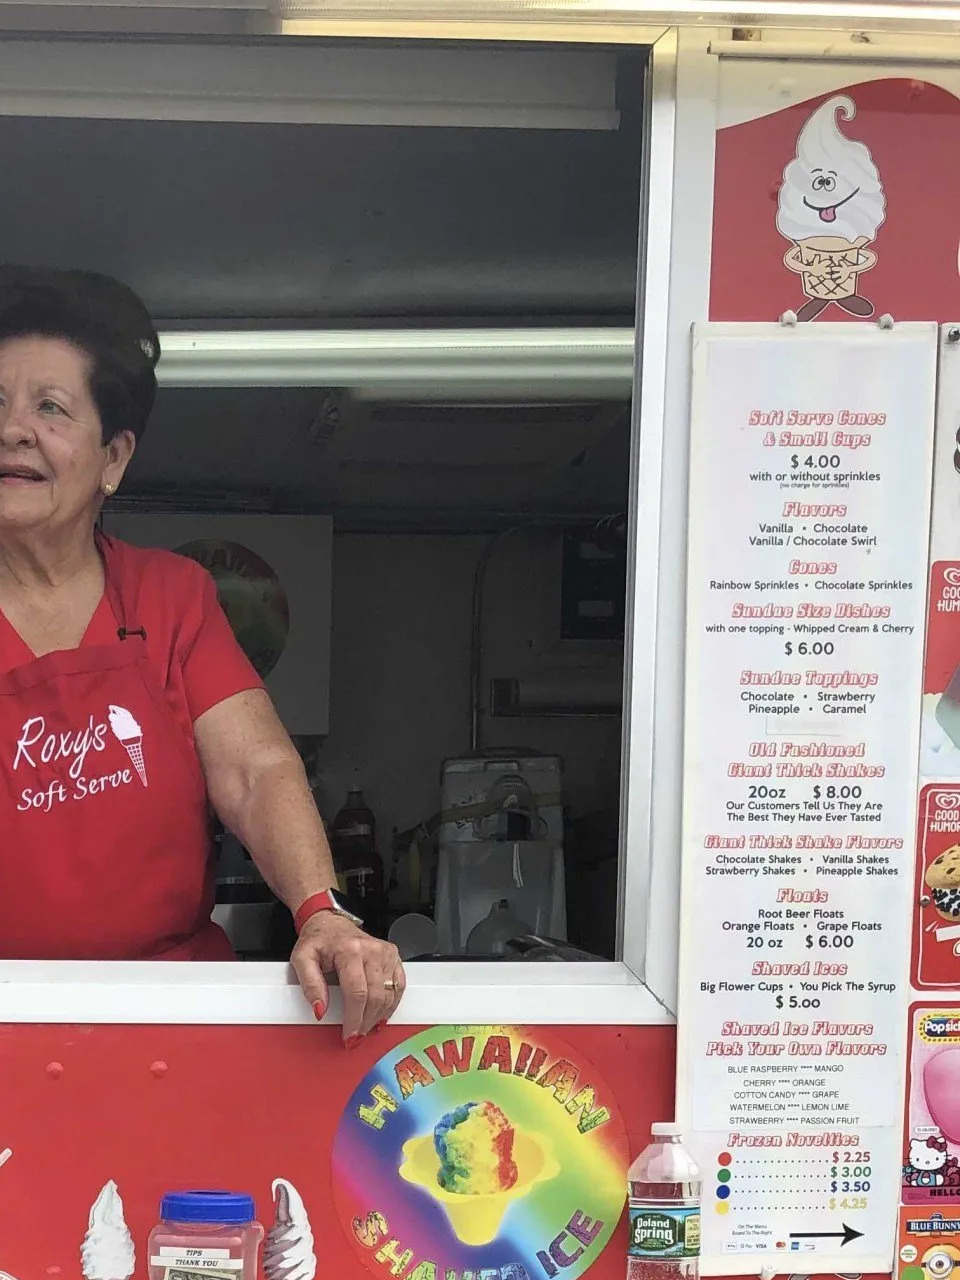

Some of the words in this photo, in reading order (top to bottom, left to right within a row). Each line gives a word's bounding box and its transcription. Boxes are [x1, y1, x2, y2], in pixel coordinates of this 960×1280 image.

[749, 410, 784, 426] Soft
[787, 410, 834, 426] Serve
[838, 410, 886, 426] Cones
[763, 432, 775, 446] &
[779, 432, 827, 446] Small
[832, 432, 871, 449] Cups
[750, 472, 771, 481] with
[790, 472, 830, 481] without
[833, 472, 881, 484] sprinkles
[783, 502, 847, 516] Flavors
[759, 523, 793, 533] Vanilla
[813, 523, 868, 533] Chocolate
[789, 560, 837, 574] Cones
[710, 581, 751, 589] Rainbow
[754, 581, 799, 591] Sprinkles
[814, 581, 866, 589] Chocolate
[869, 581, 913, 591] Sprinkles
[732, 604, 793, 618] Sundae
[797, 604, 831, 618] Size
[835, 604, 890, 618] Dishes
[740, 671, 801, 685] Sundae
[805, 671, 878, 688] Toppings
[740, 692, 794, 701] Chocolate
[817, 692, 875, 703] Strawberry
[749, 704, 800, 716] Pineapple
[823, 704, 866, 714] Caramel
[13, 715, 108, 779] Roxy's
[749, 743, 777, 757] Old
[780, 743, 866, 757] Fashioned
[728, 763, 771, 777] Giant
[776, 763, 822, 777] Thick
[826, 763, 885, 777] Shakes
[17, 780, 67, 812] Soft
[73, 768, 133, 800] Serve
[727, 813, 745, 821] The
[748, 813, 767, 821] Best
[771, 813, 795, 823] They
[798, 813, 822, 821] Have
[825, 813, 847, 821] Ever
[850, 813, 881, 821] Tasted
[935, 810, 959, 820] GOOD
[776, 888, 828, 902] Floats
[752, 961, 810, 975] Shaved
[813, 961, 848, 975] Ices
[700, 982, 715, 993] Big
[719, 982, 755, 991] Flower
[758, 982, 783, 993] Cups
[800, 982, 818, 991] You
[822, 982, 843, 991] Pick
[846, 982, 865, 991] The
[868, 982, 896, 993] Syrup
[356, 1035, 612, 1134] HAWAIIAN
[727, 1133, 782, 1147] Frozen
[786, 1133, 859, 1147] Novelties
[637, 1218, 669, 1228] Poland
[634, 1228, 674, 1244] Spring
[536, 1209, 604, 1279] ICE
